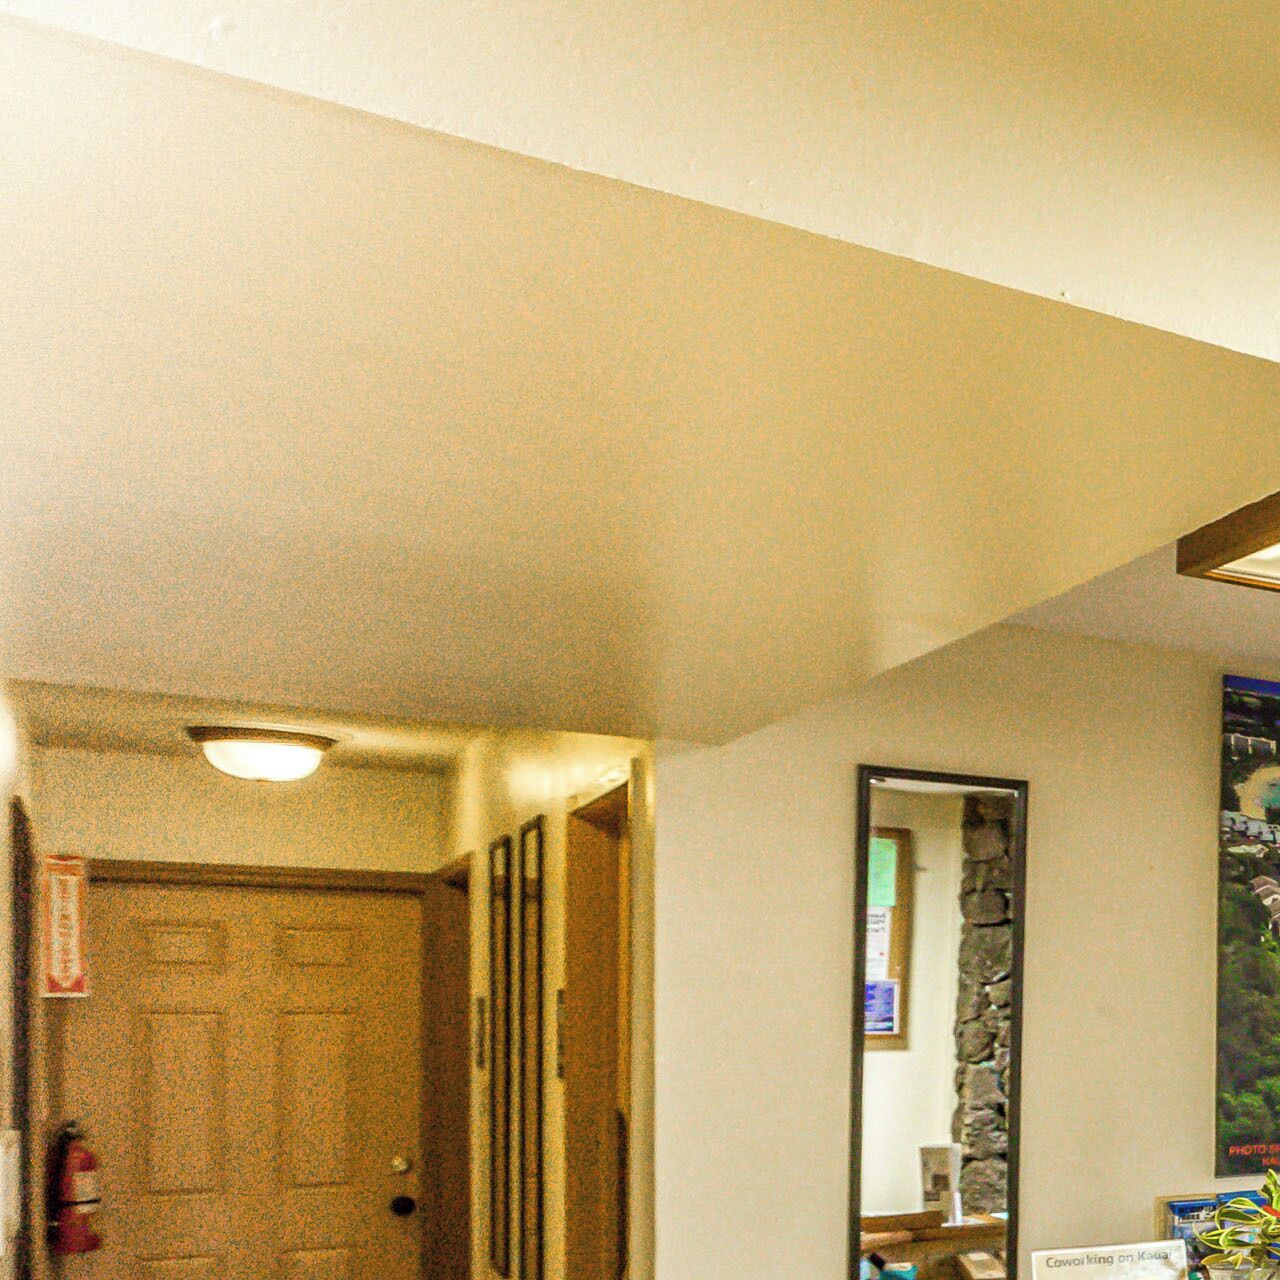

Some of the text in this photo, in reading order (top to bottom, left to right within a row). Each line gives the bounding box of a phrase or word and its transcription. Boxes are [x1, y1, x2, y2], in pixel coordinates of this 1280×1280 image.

[1228, 1144, 1267, 1157] PHOTO
[1045, 1254, 1114, 1269] Coworking
[1118, 1254, 1134, 1264] on
